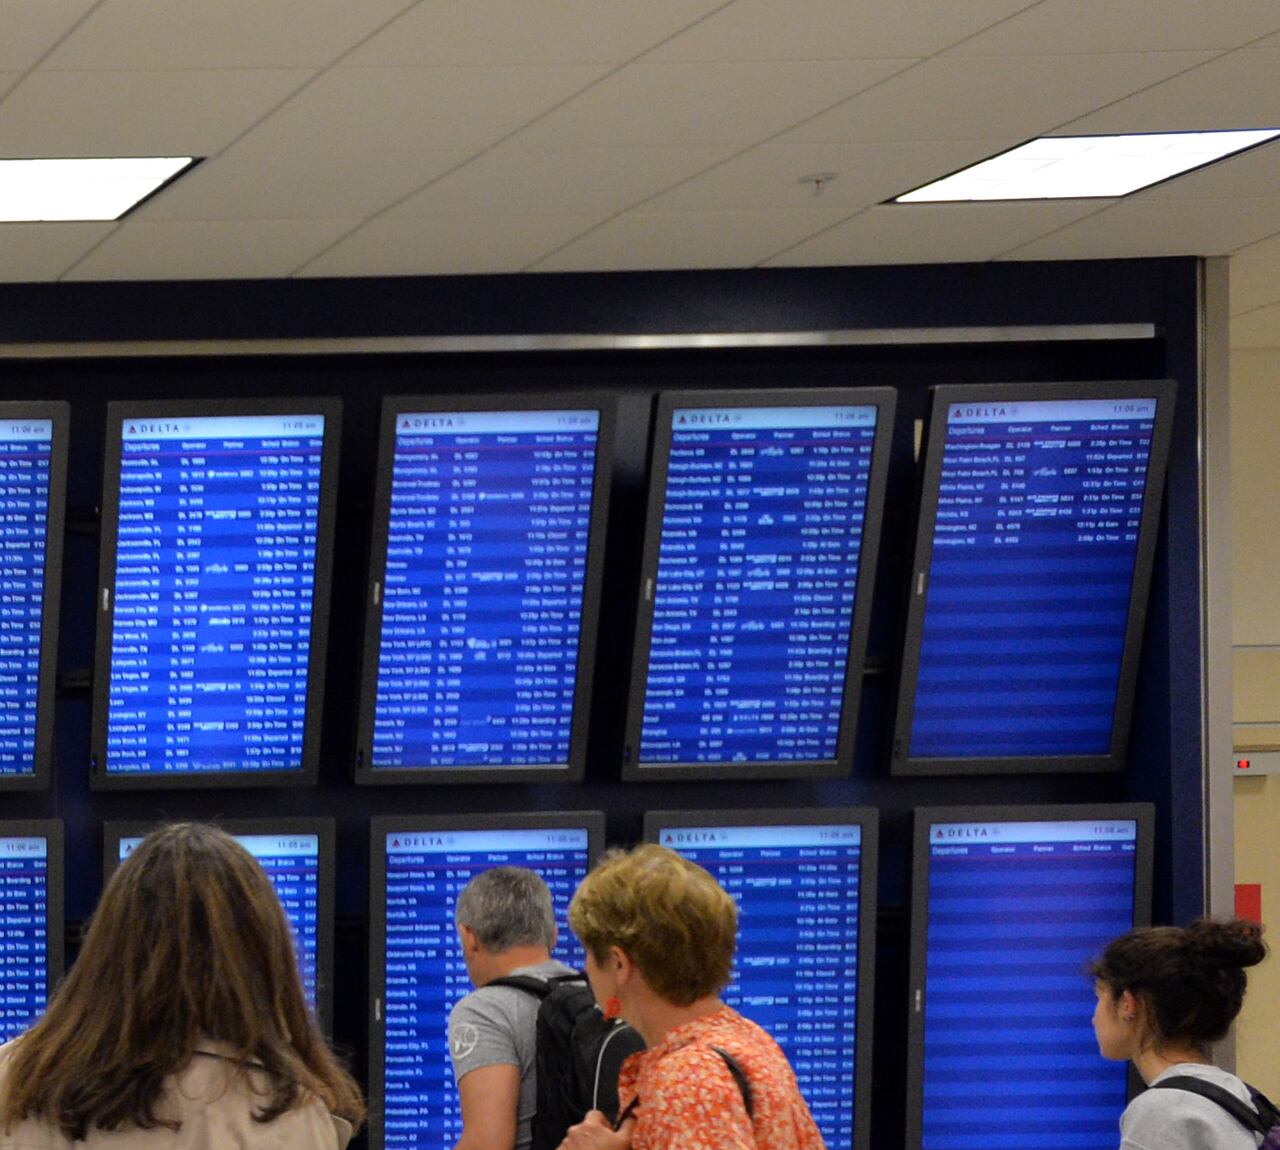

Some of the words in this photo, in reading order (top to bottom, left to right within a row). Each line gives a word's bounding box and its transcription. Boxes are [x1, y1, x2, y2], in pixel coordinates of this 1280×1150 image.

[965, 407, 1007, 417] DELTA
[414, 418, 453, 427] DELTA
[690, 414, 730, 423] DELTA
[140, 424, 179, 433] DELTA
[948, 828, 987, 837] DELTA
[404, 837, 442, 846] DELTA
[677, 833, 716, 842] DELTA
